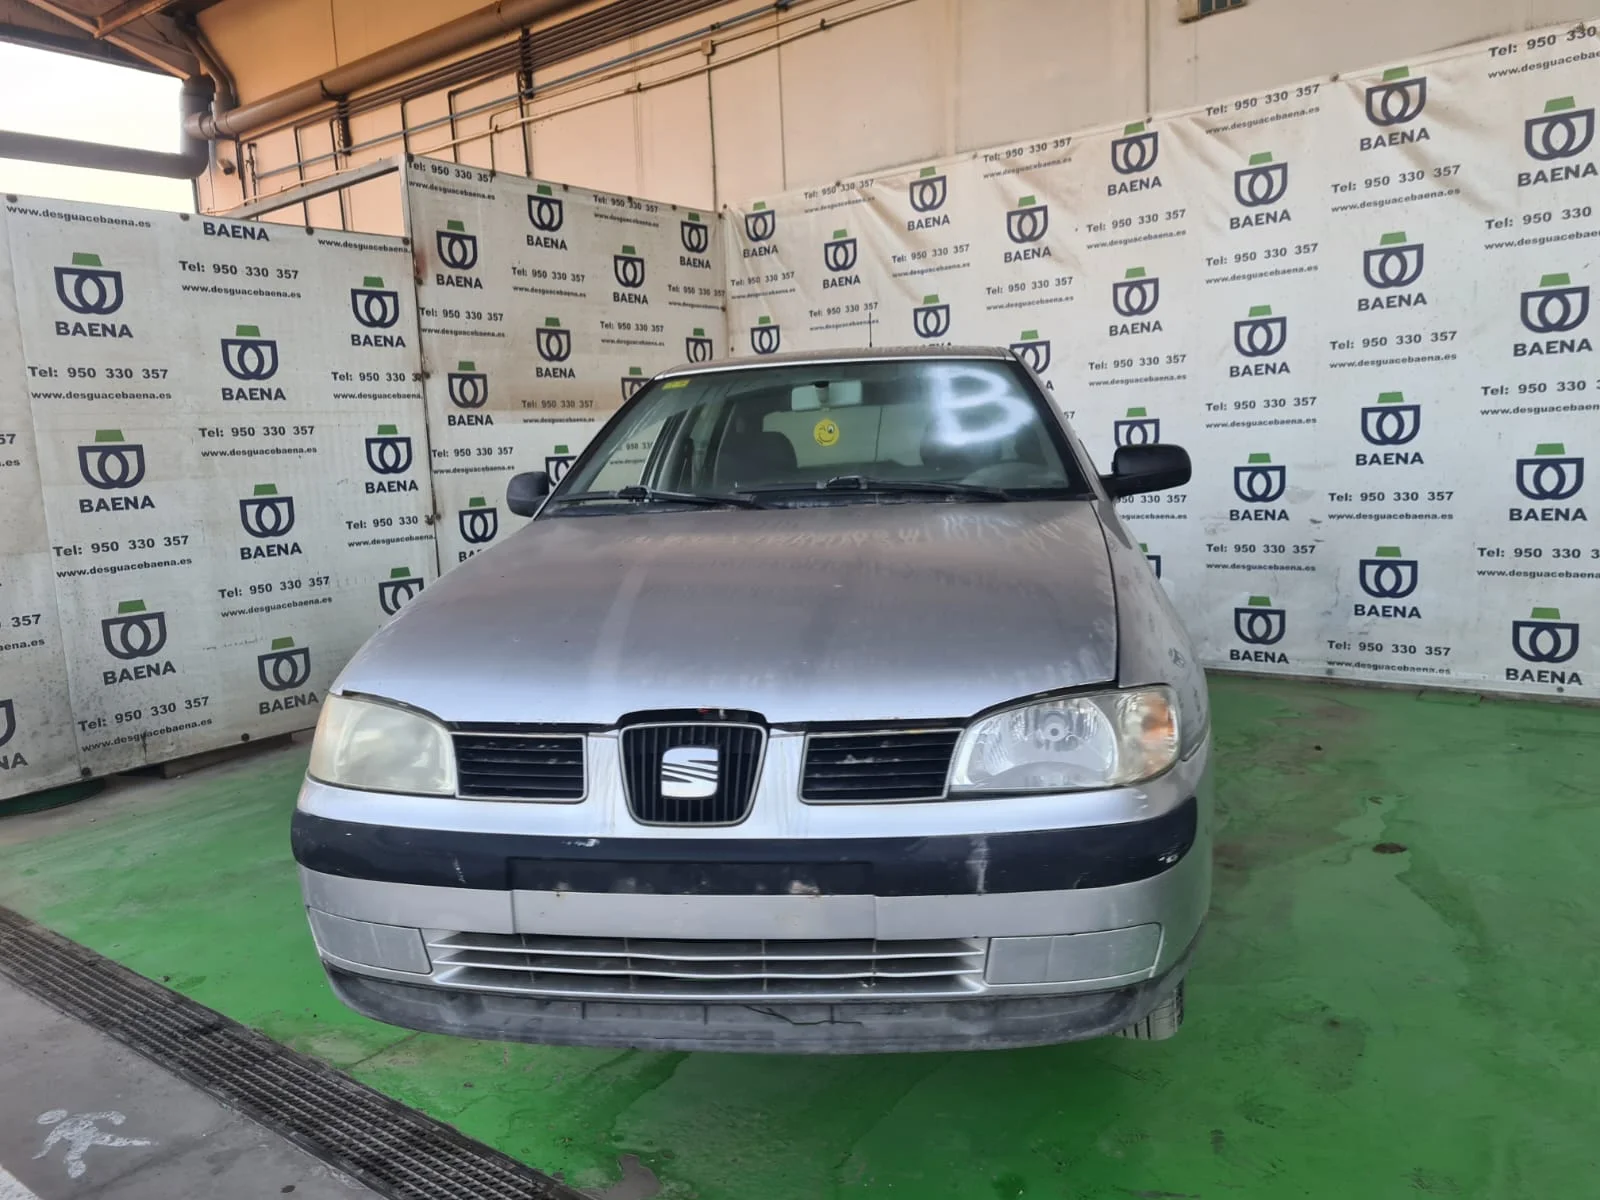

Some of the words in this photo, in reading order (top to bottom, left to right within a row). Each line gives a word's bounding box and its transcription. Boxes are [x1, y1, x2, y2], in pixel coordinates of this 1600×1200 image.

[1488, 44, 1517, 57] Tel:
[1527, 34, 1556, 49] 950
[1206, 105, 1227, 116] Tel:
[1235, 98, 1257, 110] 950
[1265, 91, 1288, 104] 330
[1296, 84, 1320, 97] 357
[1360, 128, 1430, 151] BAENA
[983, 153, 1000, 162] Tel:
[1006, 148, 1023, 159] 950
[1030, 143, 1047, 153] 330
[1053, 137, 1072, 148] 357
[431, 164, 449, 176] 950
[455, 169, 472, 180] 330
[1331, 182, 1356, 193] Tel:
[1365, 176, 1390, 188] 950
[1399, 170, 1424, 183] 330
[1434, 165, 1460, 178] 357
[1518, 162, 1598, 187] BAENA
[1108, 176, 1162, 196] BAENA
[1332, 189, 1460, 212] www.desguacebaena.es
[7, 206, 151, 228] www.desguacebaena.es
[907, 214, 950, 231] BAENA
[1087, 223, 1105, 232] Tel:
[1112, 218, 1131, 229] 950
[1139, 214, 1158, 224] 330
[1166, 209, 1185, 220] 357
[1230, 209, 1291, 229] BAENA
[1485, 218, 1512, 229] Tel:
[1523, 212, 1552, 225] 950
[1562, 207, 1591, 219] 330
[203, 221, 270, 242] BAENA
[527, 234, 568, 251] BAENA
[911, 251, 927, 260] 950
[932, 248, 948, 257] 330
[954, 244, 969, 253] 357
[1004, 246, 1052, 263] BAENA
[1206, 256, 1227, 266] Tel:
[1234, 252, 1256, 263] 950
[1264, 248, 1287, 259] 330
[1295, 243, 1318, 255] 357
[178, 260, 205, 272] Tel:
[213, 264, 237, 275] 950
[245, 266, 269, 277] 330
[276, 269, 299, 279] 357
[680, 256, 711, 269] BAENA
[436, 273, 483, 289] BAENA
[512, 267, 527, 277] Tel:
[532, 269, 547, 279] 950
[552, 271, 567, 281] 330
[571, 273, 585, 283] 357
[823, 275, 861, 289] BAENA
[182, 285, 301, 298] www.desguacebaena.es
[986, 286, 1002, 295] Tel:
[1008, 283, 1025, 292] 950
[1032, 280, 1049, 289] 330
[1056, 277, 1072, 286] 357
[613, 292, 648, 305] BAENA
[1358, 293, 1427, 311] BAENA
[442, 309, 460, 319] 950
[465, 311, 482, 320] 330
[488, 312, 503, 321] 357
[55, 321, 133, 338] BAENA
[1109, 320, 1162, 336] BAENA
[351, 334, 406, 348] BAENA
[1330, 340, 1354, 350] Tel:
[1362, 337, 1387, 348] 950
[1396, 334, 1421, 345] 330
[1431, 331, 1457, 342] 357
[1513, 338, 1592, 357] BAENA
[1088, 361, 1107, 370] Tel:
[1114, 359, 1133, 368] 950
[1140, 357, 1159, 366] 330
[1166, 354, 1186, 364] 357
[1330, 354, 1456, 368] www.desguacebaena.es
[27, 366, 58, 377] Tel:
[67, 367, 96, 378] 950
[105, 368, 133, 379] 330
[142, 369, 168, 379] 357
[331, 372, 352, 381] Tel:
[359, 372, 379, 381] 950
[386, 372, 405, 382] 330
[536, 367, 575, 378] BAENA
[1230, 362, 1290, 378] BAENA
[31, 391, 171, 401] www.desguacebaena.es
[222, 387, 286, 401] BAENA
[1481, 385, 1509, 396] Tel:
[1518, 383, 1547, 394] 950
[1557, 380, 1586, 392] 330
[926, 362, 1034, 448] B
[1206, 402, 1227, 411] Tel:
[1234, 400, 1256, 410] 950
[1264, 399, 1286, 408] 330
[1294, 397, 1317, 406] 357
[448, 414, 494, 426] BAENA
[198, 427, 224, 438] Tel:
[231, 427, 255, 437] 950
[263, 426, 286, 436] 330
[293, 426, 314, 435] 357
[201, 447, 317, 457] www.desguacebaena.es
[432, 449, 449, 458] Tel:
[454, 448, 471, 457] 950
[476, 447, 492, 456] 330
[498, 447, 513, 455] 357
[1356, 452, 1424, 466] BAENA
[365, 480, 419, 494] BAENA
[79, 495, 155, 513] BAENA
[1141, 495, 1160, 503] 330
[1167, 494, 1187, 503] 357
[1328, 492, 1352, 502] Tel:
[1360, 492, 1385, 501] 950
[1393, 492, 1419, 501] 330
[1428, 491, 1453, 501] 357
[1230, 509, 1289, 521] BAENA
[1509, 508, 1587, 521] BAENA
[345, 520, 367, 530] Tel:
[373, 517, 392, 528] 950
[399, 516, 418, 525] 330
[52, 545, 82, 557] Tel:
[91, 541, 119, 553] 950
[128, 538, 155, 550] 330
[163, 535, 188, 547] 357
[240, 542, 302, 560] BAENA
[1206, 544, 1227, 552] Tel:
[1234, 544, 1256, 553] 950
[1263, 544, 1285, 553] 330
[1293, 545, 1316, 554] 357
[1477, 547, 1504, 557] Tel:
[1514, 548, 1542, 558] 950
[1552, 548, 1581, 559] 330
[56, 559, 192, 578] www.desguacebaena.es
[218, 587, 242, 599] Tel:
[249, 583, 272, 595] 950
[280, 579, 302, 591] 330
[309, 576, 330, 587] 357
[221, 597, 332, 617] www.desguacebaena.es
[1354, 604, 1421, 619] BAENA
[11, 614, 41, 628] 357
[1327, 640, 1351, 650] Tel:
[1359, 642, 1383, 652] 950
[1392, 644, 1416, 654] 330
[1425, 646, 1451, 656] 357
[1230, 649, 1289, 664] BAENA
[103, 661, 176, 686] BAENA
[1506, 668, 1583, 686] BAENA
[259, 691, 319, 716] BAENA
[78, 717, 107, 732] Tel:
[115, 710, 142, 724] 950
[150, 702, 177, 717] 330
[185, 696, 209, 709] 357
